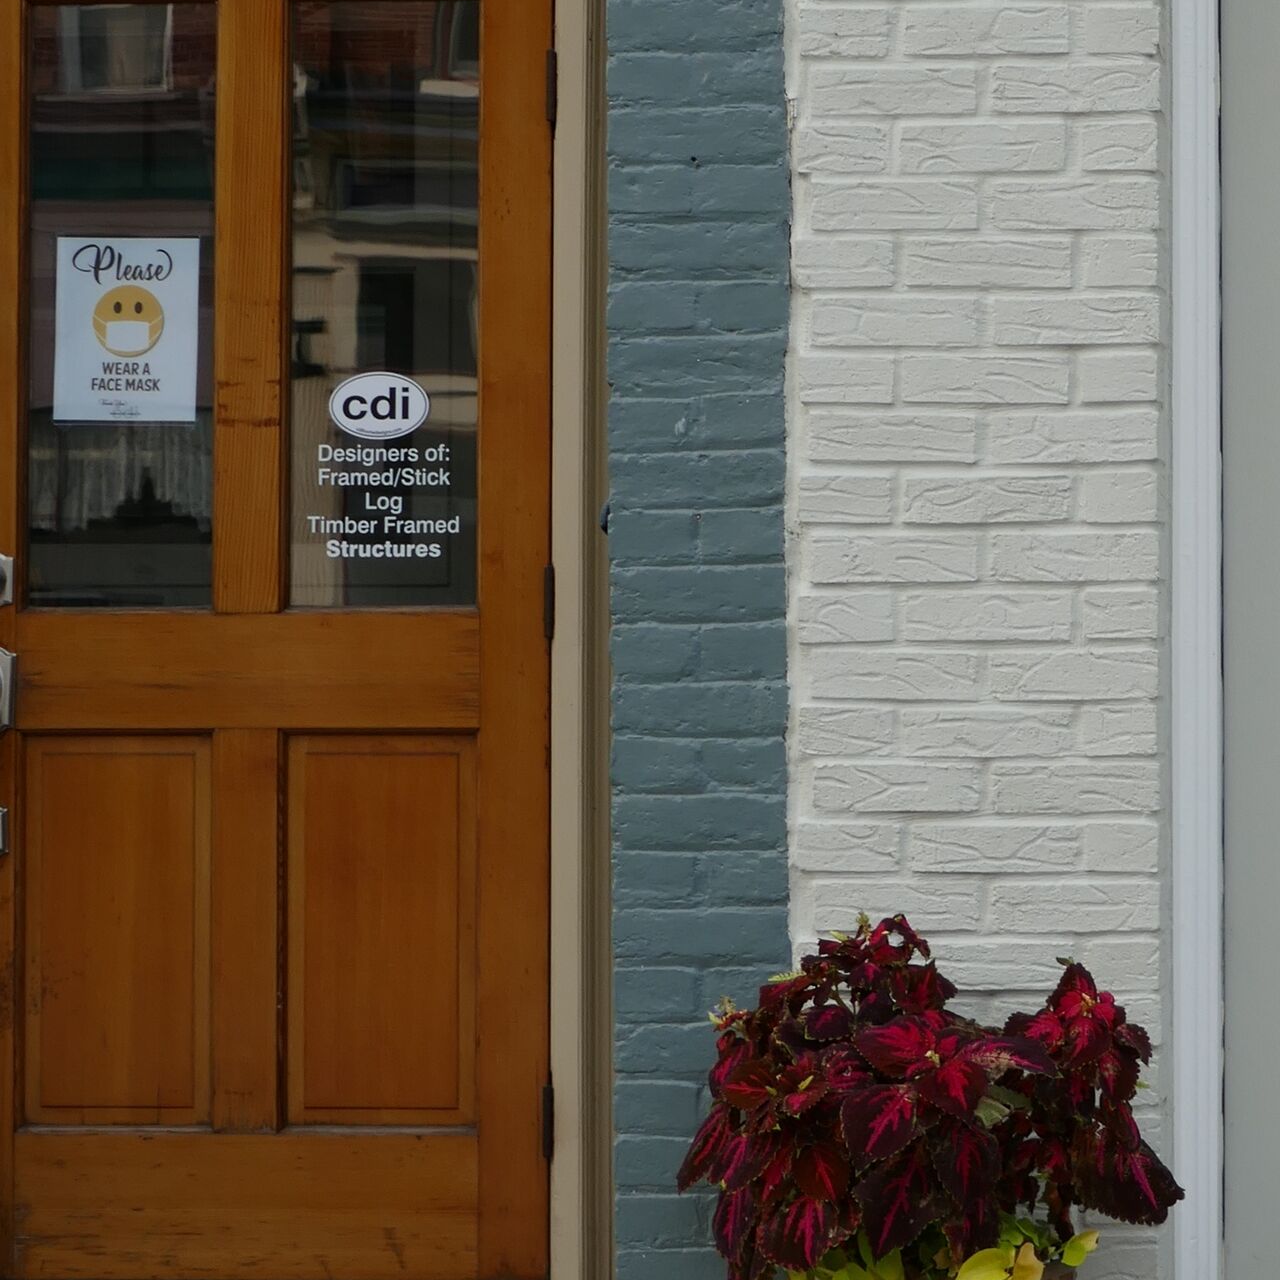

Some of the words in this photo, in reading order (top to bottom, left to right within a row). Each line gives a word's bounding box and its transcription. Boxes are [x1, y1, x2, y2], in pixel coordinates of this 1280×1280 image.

[71, 243, 174, 285] Please
[101, 361, 139, 376] WEAR
[141, 361, 151, 376] A
[90, 377, 122, 392] FACE
[124, 377, 161, 392] MASK
[342, 386, 410, 421] cdi
[317, 444, 419, 466] Designers
[424, 444, 451, 463] of:
[317, 468, 451, 487] Framed/Stick
[364, 493, 403, 515] Log
[307, 516, 377, 534] Timber
[383, 516, 460, 534] Framed
[325, 539, 442, 559] Structures
